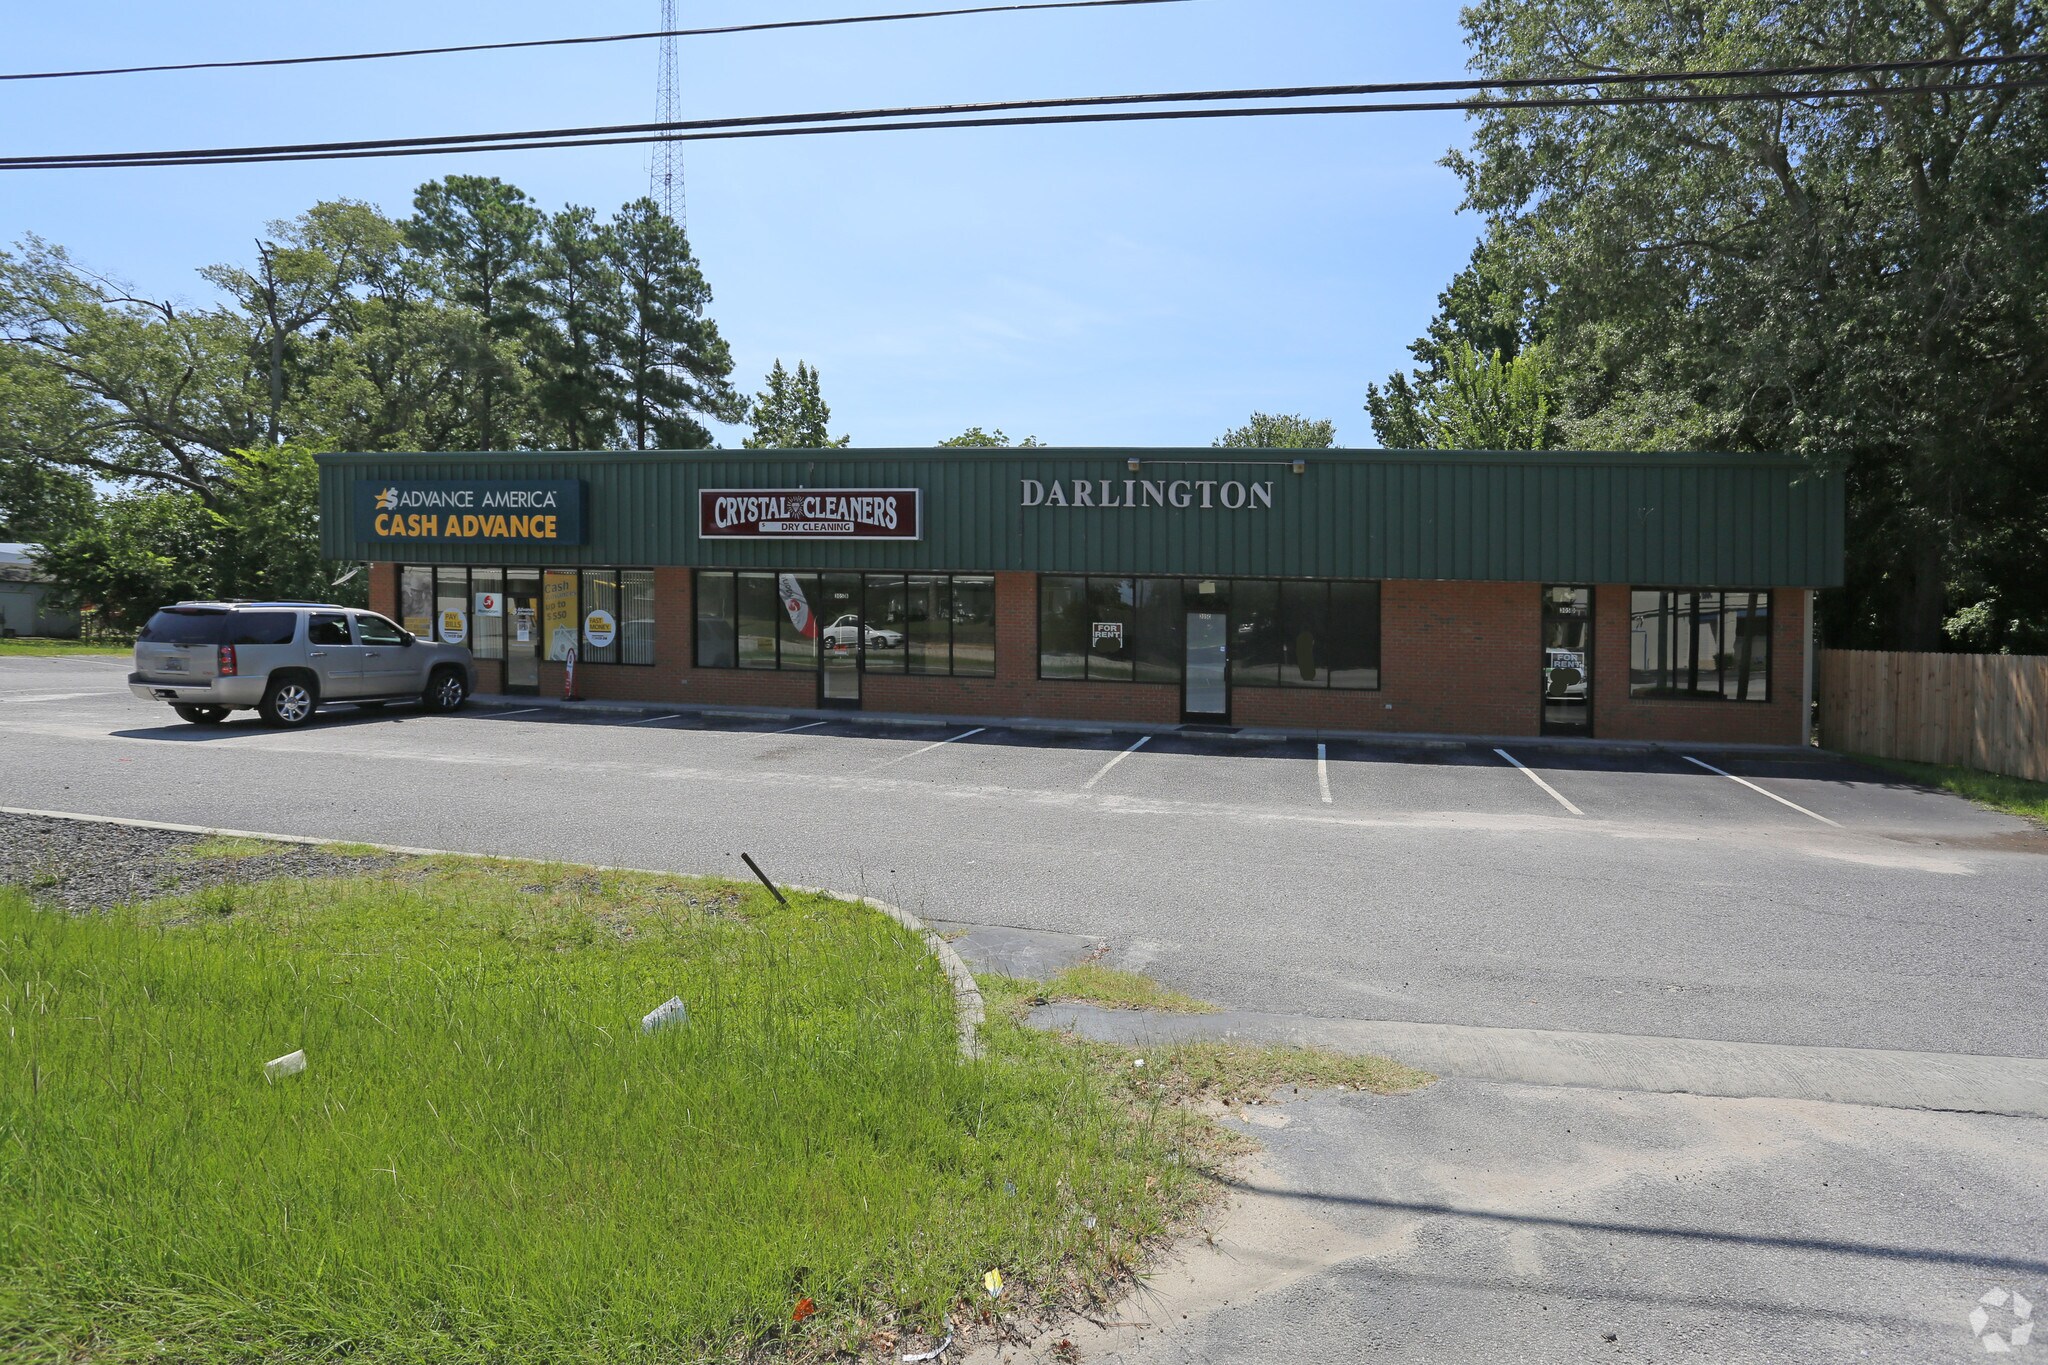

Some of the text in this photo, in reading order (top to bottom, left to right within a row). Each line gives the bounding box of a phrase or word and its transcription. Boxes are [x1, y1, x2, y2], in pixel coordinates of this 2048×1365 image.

[400, 491, 556, 508] ADVANCE AMERICA
[1020, 479, 1274, 509] DARLINGTON
[715, 497, 897, 530] CRYSTAL CLEANERS
[374, 514, 557, 538] CASH ADVANCE
[781, 523, 850, 531] DRY CLEANING
[545, 580, 569, 594] Cash
[557, 600, 566, 608] to
[1095, 631, 1120, 639] RENT
[1554, 660, 1582, 668] RENT
